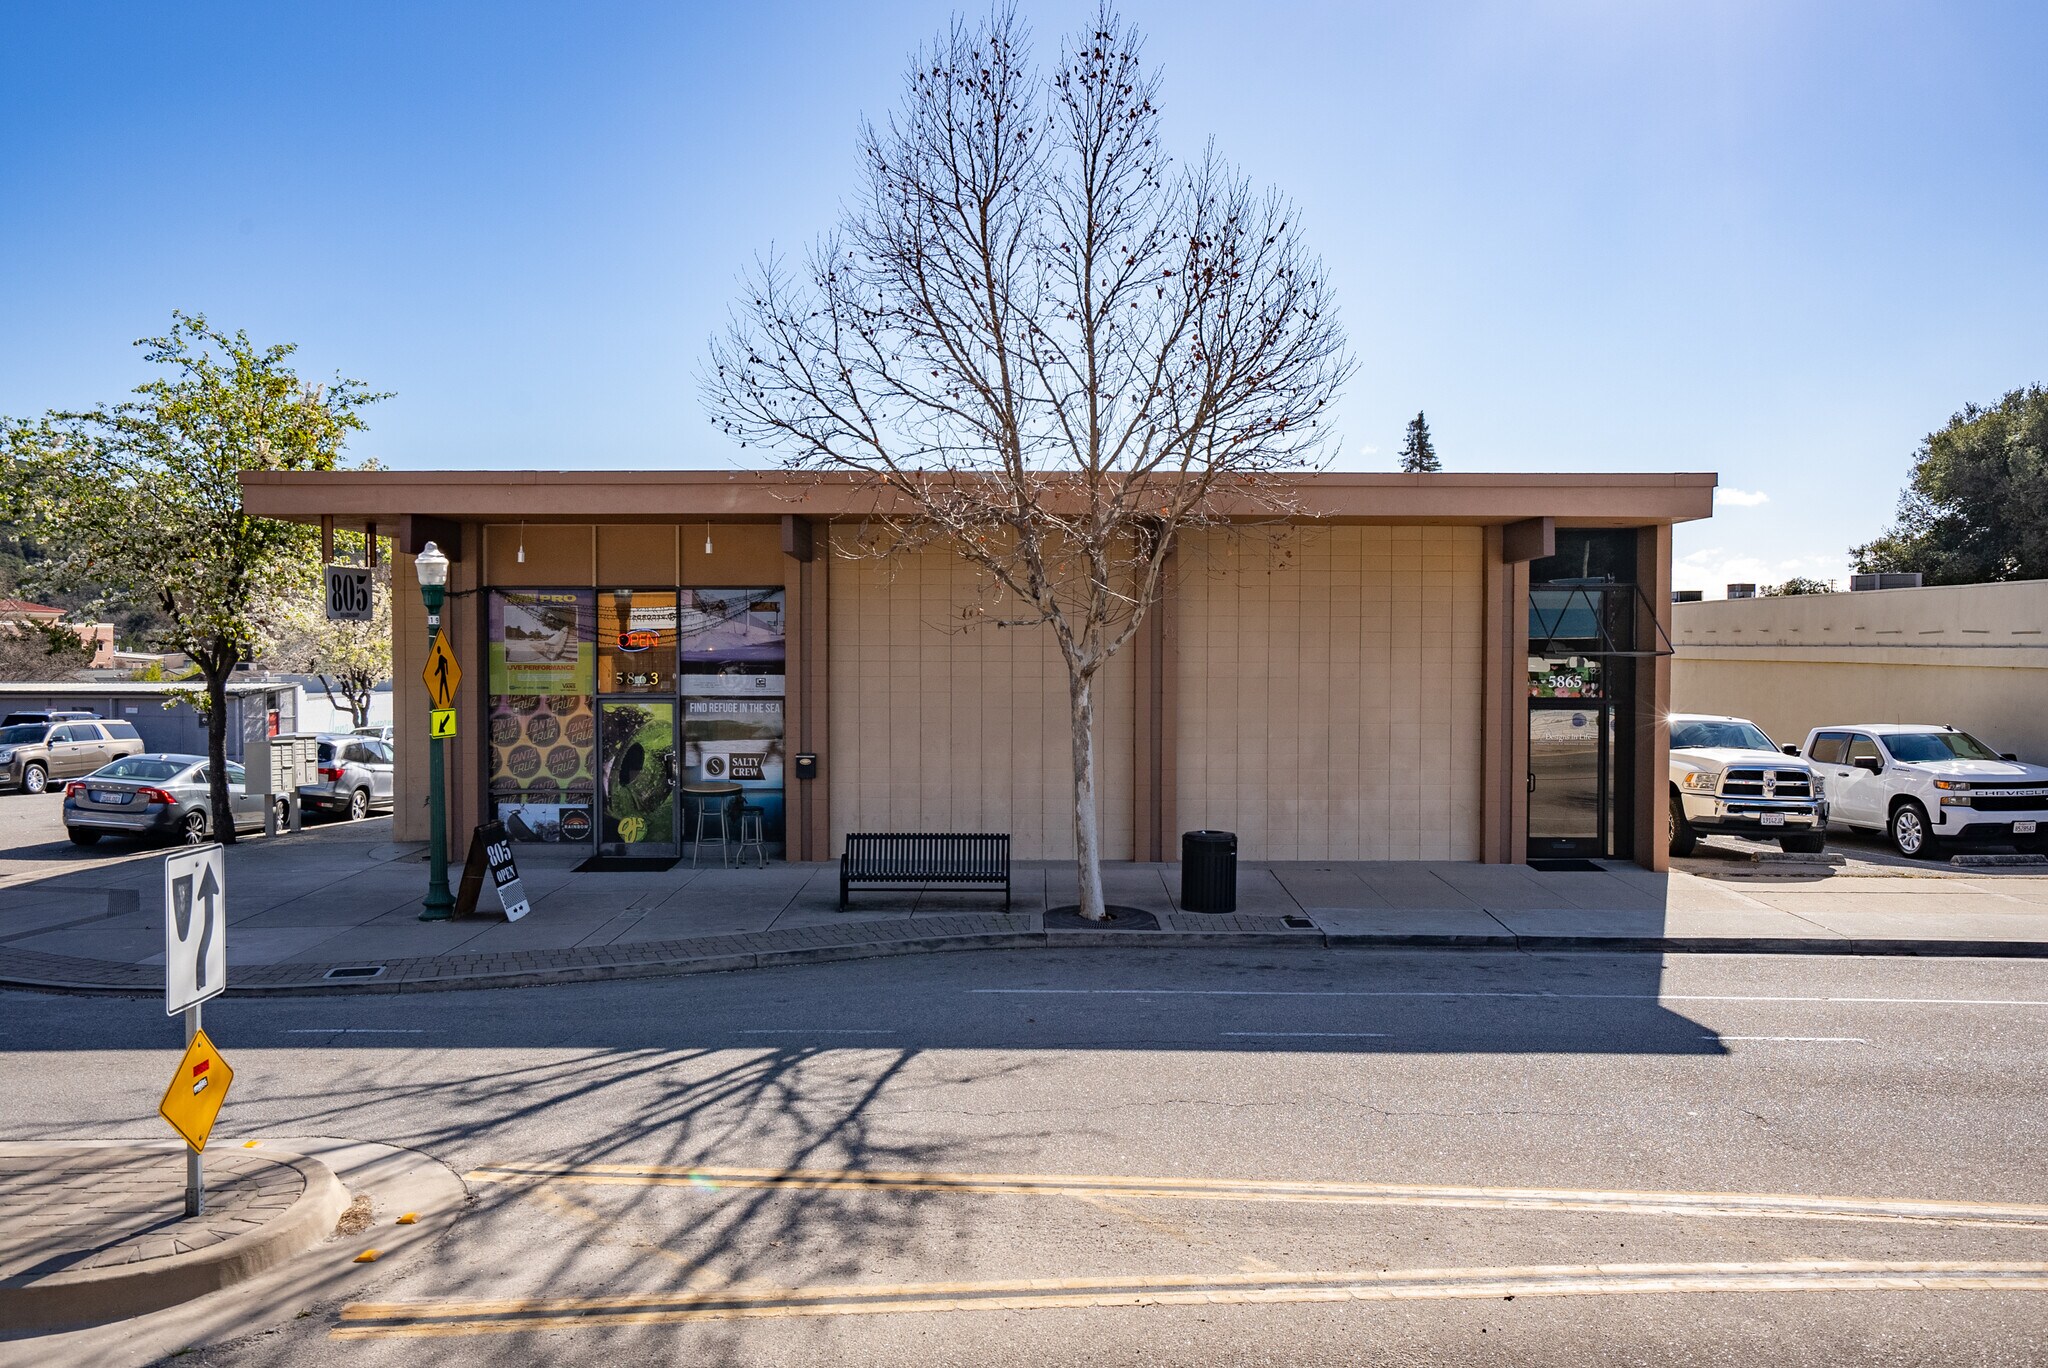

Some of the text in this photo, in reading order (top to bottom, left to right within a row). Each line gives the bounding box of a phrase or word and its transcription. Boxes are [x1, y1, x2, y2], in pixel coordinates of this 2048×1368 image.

[332, 574, 368, 612] 805
[540, 594, 577, 602] PRO
[617, 633, 658, 647] OPEN
[615, 672, 659, 685] 5863
[1548, 675, 1582, 688] 5865
[690, 703, 780, 713] FIND REFUGE IN THE SEA
[526, 716, 556, 735] SANTA
[532, 728, 556, 744] CRUZ
[508, 748, 537, 766] SANTA
[547, 748, 576, 766] SANTA
[732, 758, 760, 766] SALTY
[512, 760, 537, 775] CRUZ
[551, 760, 576, 775] CRUZ
[732, 767, 759, 776] CREW
[486, 839, 512, 867] 805
[496, 865, 516, 883] OPEN
